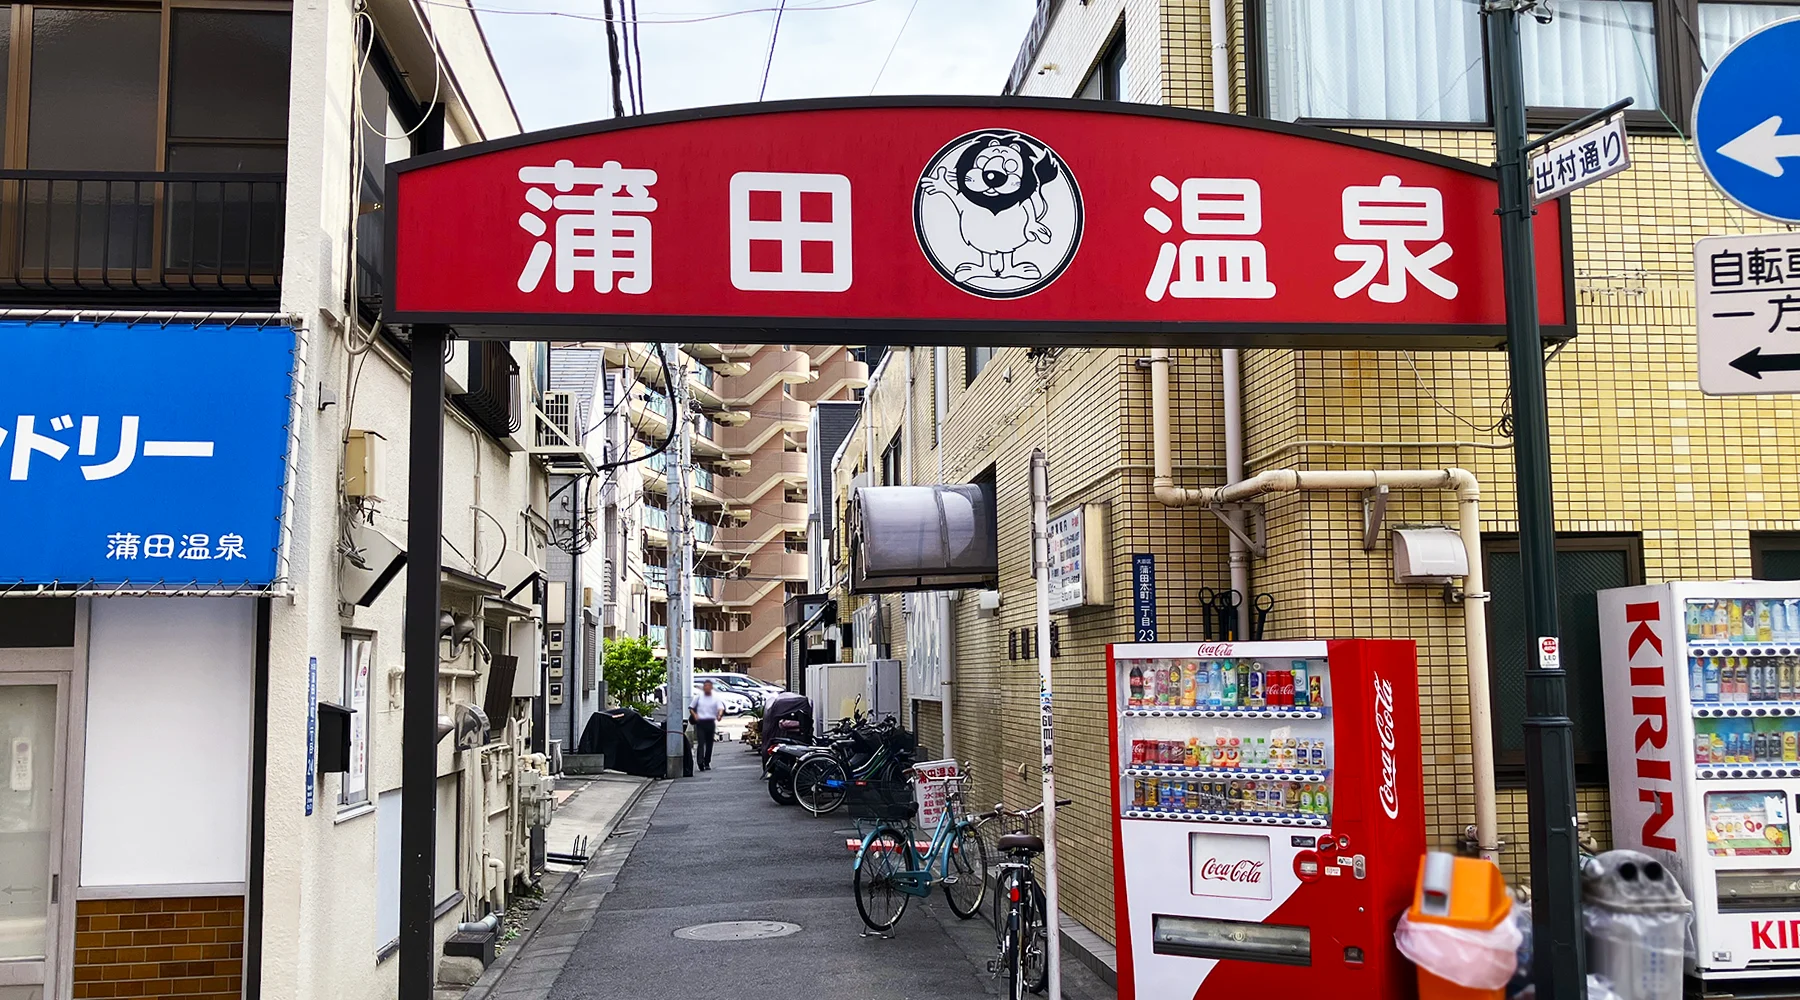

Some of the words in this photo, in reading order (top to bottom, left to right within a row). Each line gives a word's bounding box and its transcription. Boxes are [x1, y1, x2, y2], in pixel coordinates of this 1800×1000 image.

[1535, 130, 1621, 194] 出村通り
[517, 159, 853, 294] 蒲田
[1143, 175, 1459, 302] 温泉
[0, 414, 214, 481] ドリー
[106, 532, 247, 560] 蒲田温泉
[1139, 565, 1151, 627] 蒲田本町二丁目
[1139, 629, 1155, 642] 23
[1374, 671, 1399, 820] Coca-Cola
[1625, 601, 1677, 853] KIRIN
[1201, 857, 1264, 883] Coca-Cola
